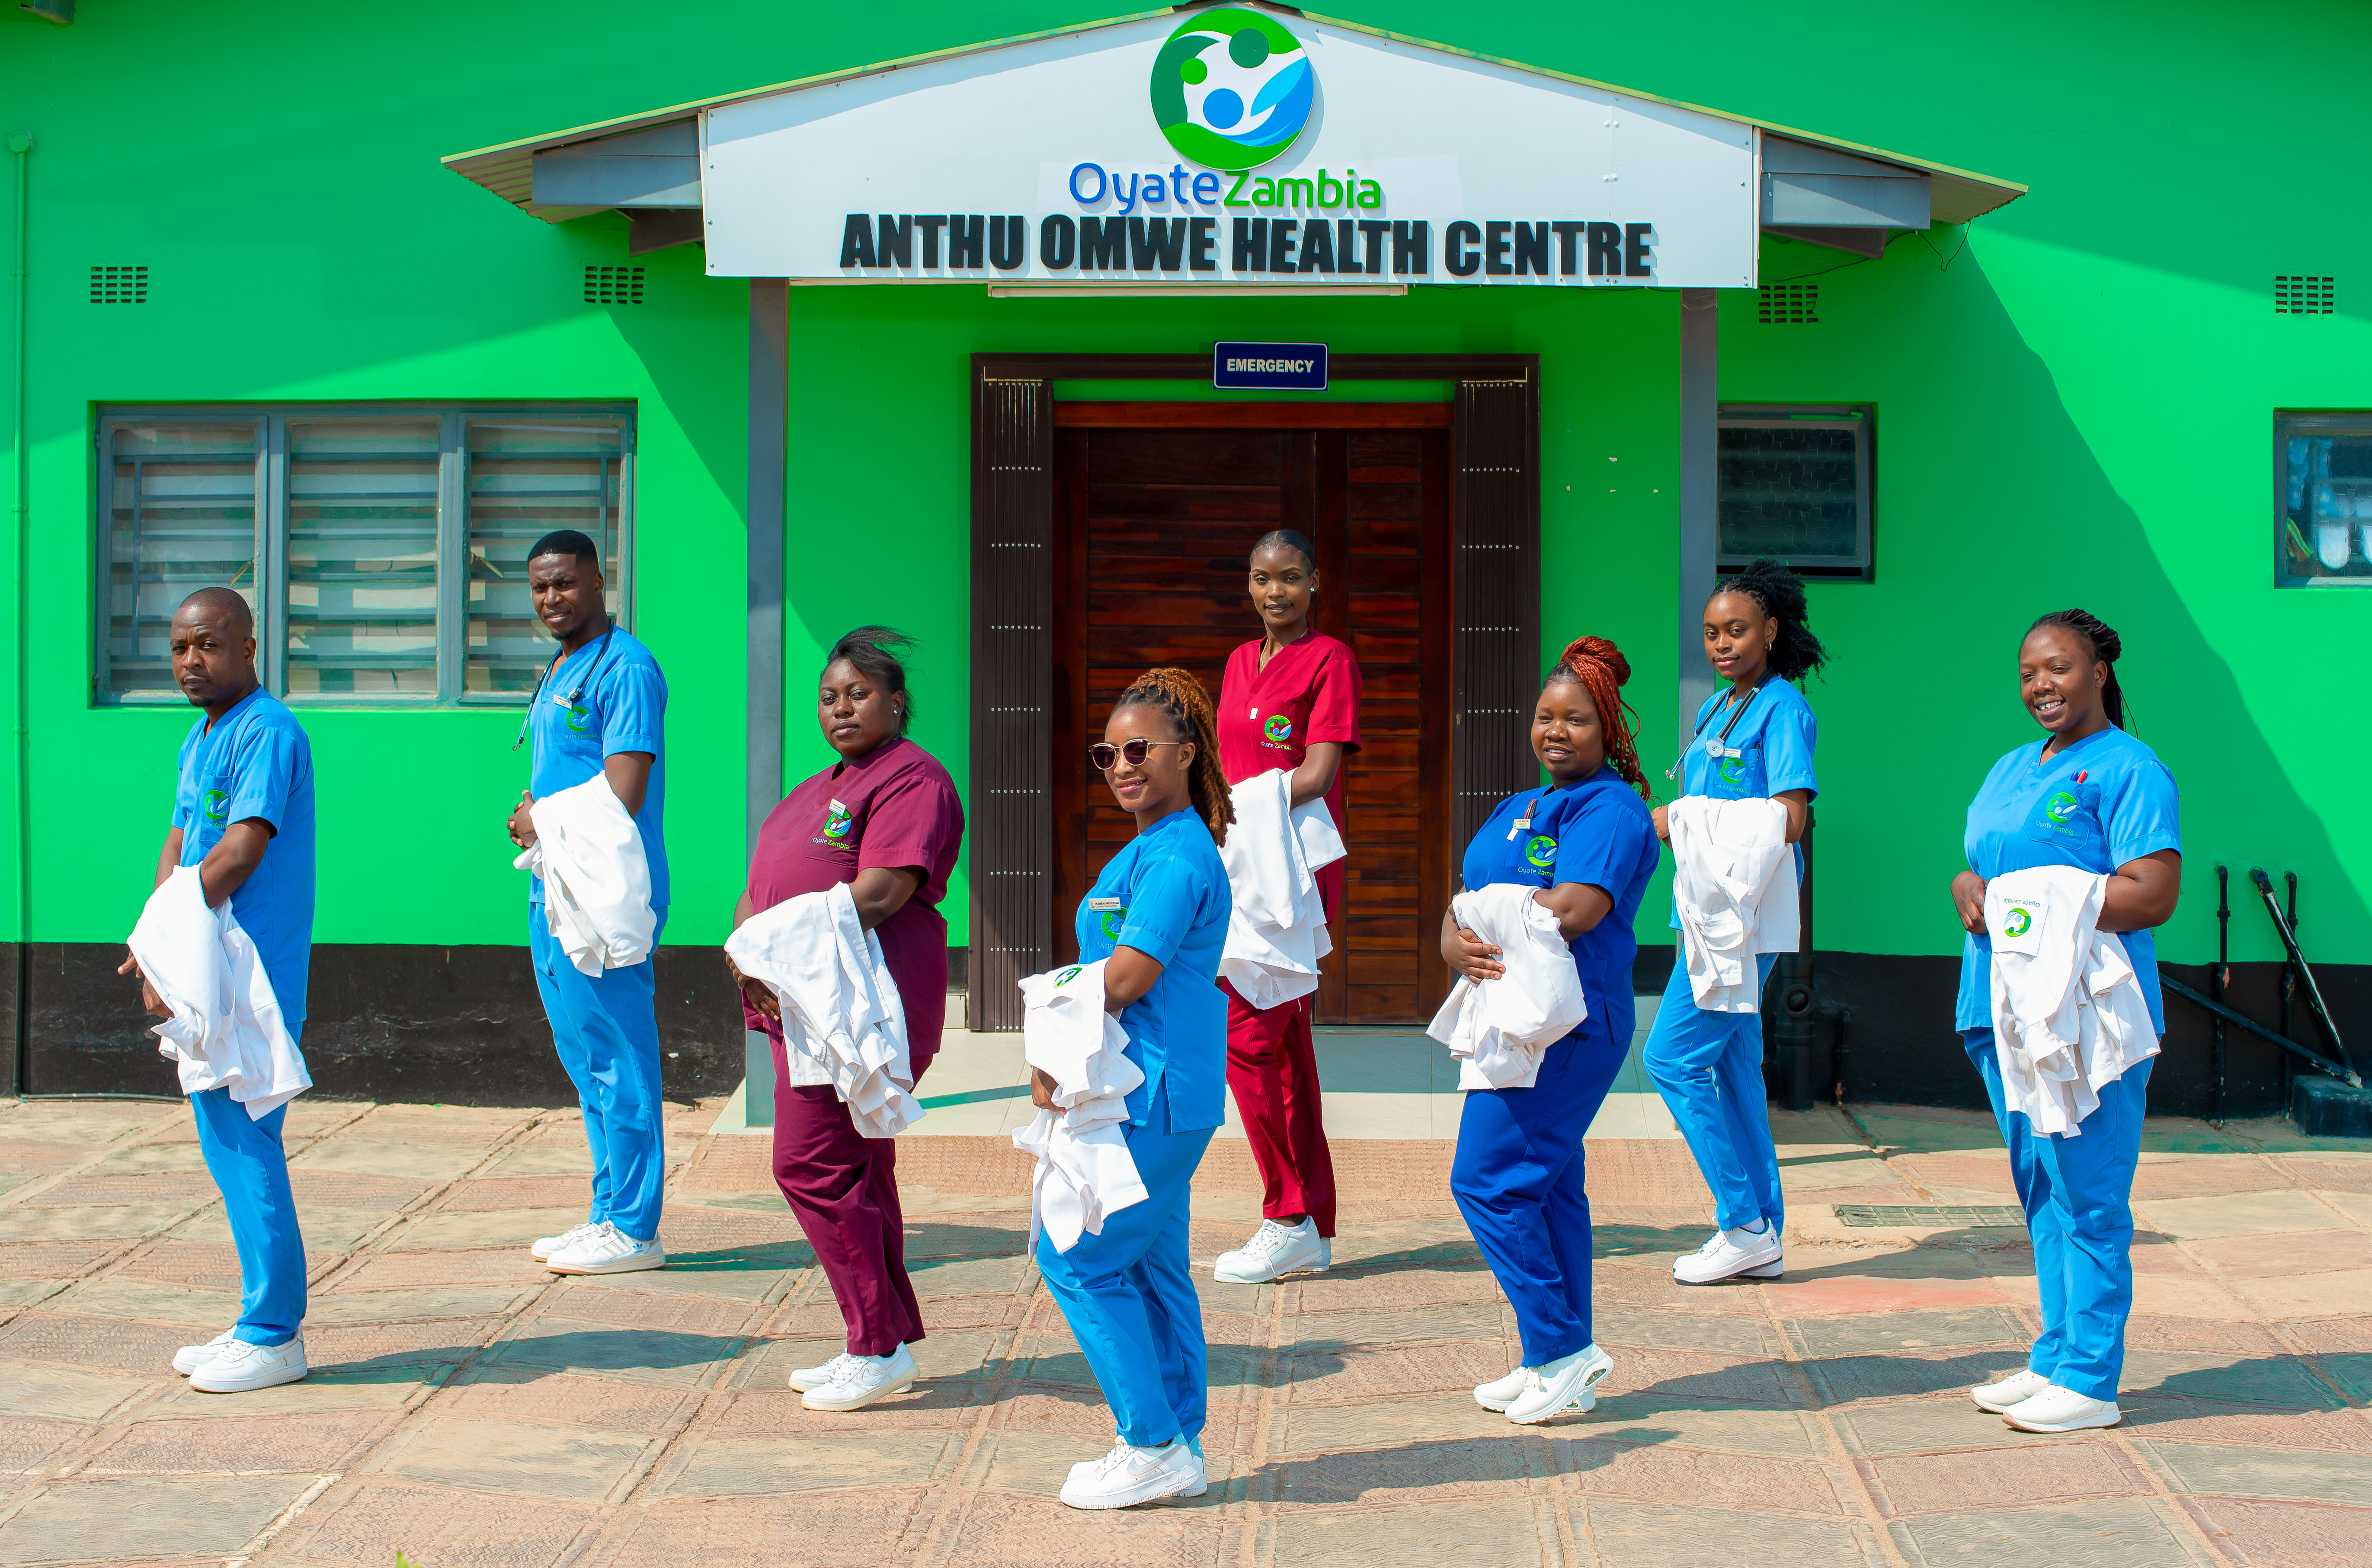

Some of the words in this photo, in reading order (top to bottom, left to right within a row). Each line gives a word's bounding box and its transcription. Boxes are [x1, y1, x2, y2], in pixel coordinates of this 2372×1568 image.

[839, 213, 1024, 270] ANTHU
[1040, 214, 1216, 272] OMWE
[1232, 217, 1428, 275] HEALTH
[1444, 220, 1652, 277] CENTRE
[1226, 358, 1314, 373] EMERGENCY
[2052, 824, 2074, 835] Zambia
[827, 839, 850, 850] Zambia
[1176, 1475, 1187, 1485] AIR
